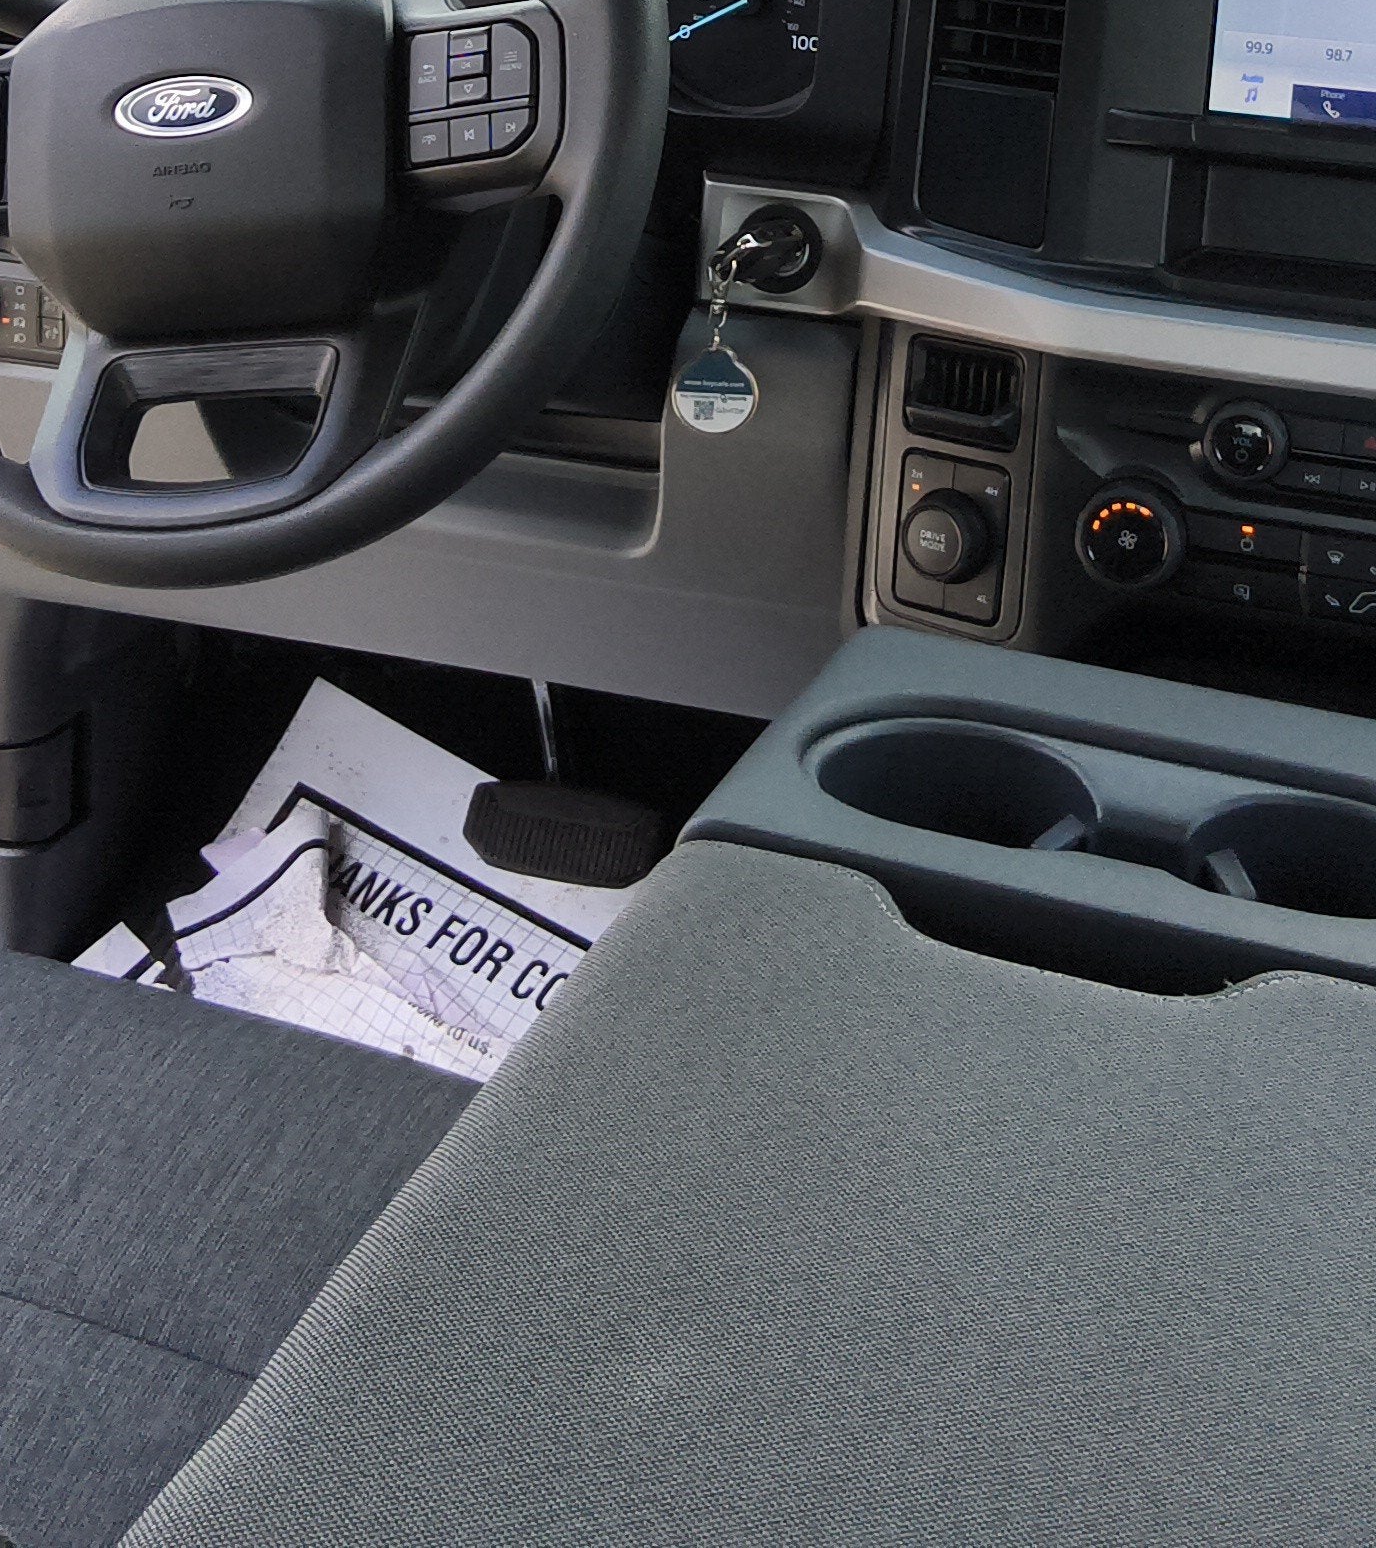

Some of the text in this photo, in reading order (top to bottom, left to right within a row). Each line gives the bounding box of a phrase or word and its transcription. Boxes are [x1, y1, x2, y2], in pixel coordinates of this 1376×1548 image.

[1244, 40, 1274, 56] 99.9
[1324, 47, 1353, 63] 98.7
[1320, 89, 1346, 100] Phone
[148, 88, 218, 123] Ford
[919, 529, 946, 543] DRIVE
[919, 538, 946, 553] MODE
[328, 858, 435, 937] ANKS
[425, 913, 515, 984] FOR
